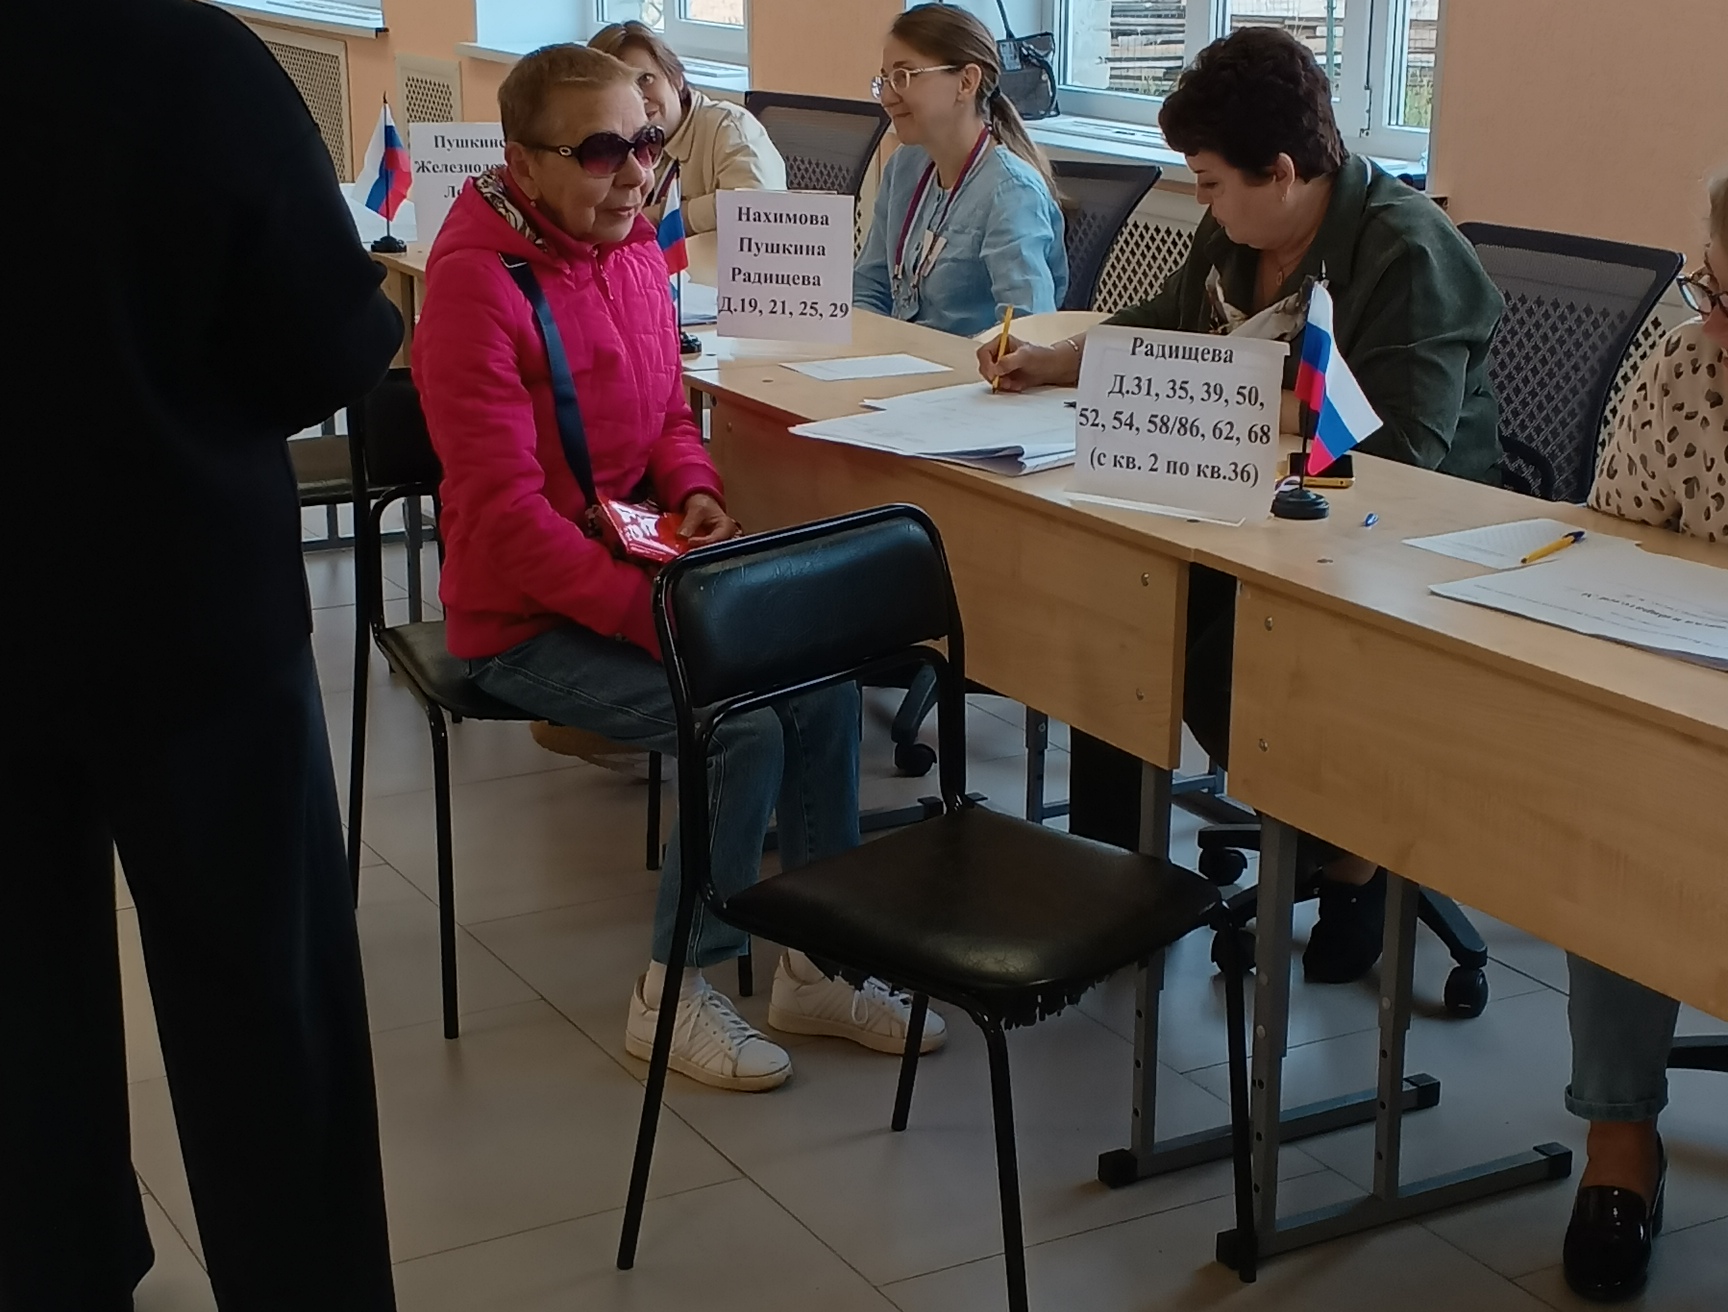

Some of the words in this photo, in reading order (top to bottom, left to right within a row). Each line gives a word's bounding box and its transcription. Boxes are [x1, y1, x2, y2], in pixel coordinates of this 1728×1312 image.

[737, 206, 830, 226] Нахимова
[738, 237, 826, 257] Пушкина
[731, 267, 821, 287] Радищева
[718, 296, 763, 316] Д.19,
[769, 299, 794, 318] 21,
[799, 301, 823, 320] 25,
[828, 302, 850, 319] 29
[1130, 337, 1234, 364] Радищева
[1107, 374, 1160, 401] Д.31,
[1166, 379, 1195, 404] 35,
[1200, 382, 1229, 408] 39,
[1235, 386, 1265, 410] 50,
[1078, 407, 1106, 432] 52,
[1111, 410, 1141, 436] 54,
[1146, 414, 1206, 442] 58/86,
[1212, 420, 1241, 446] 62,
[1247, 424, 1271, 445] 68
[1090, 447, 1106, 470] (с
[1113, 454, 1142, 471] кв.
[1148, 453, 1159, 473] 2
[1166, 460, 1190, 476] по
[1196, 461, 1259, 488] кв.36)
